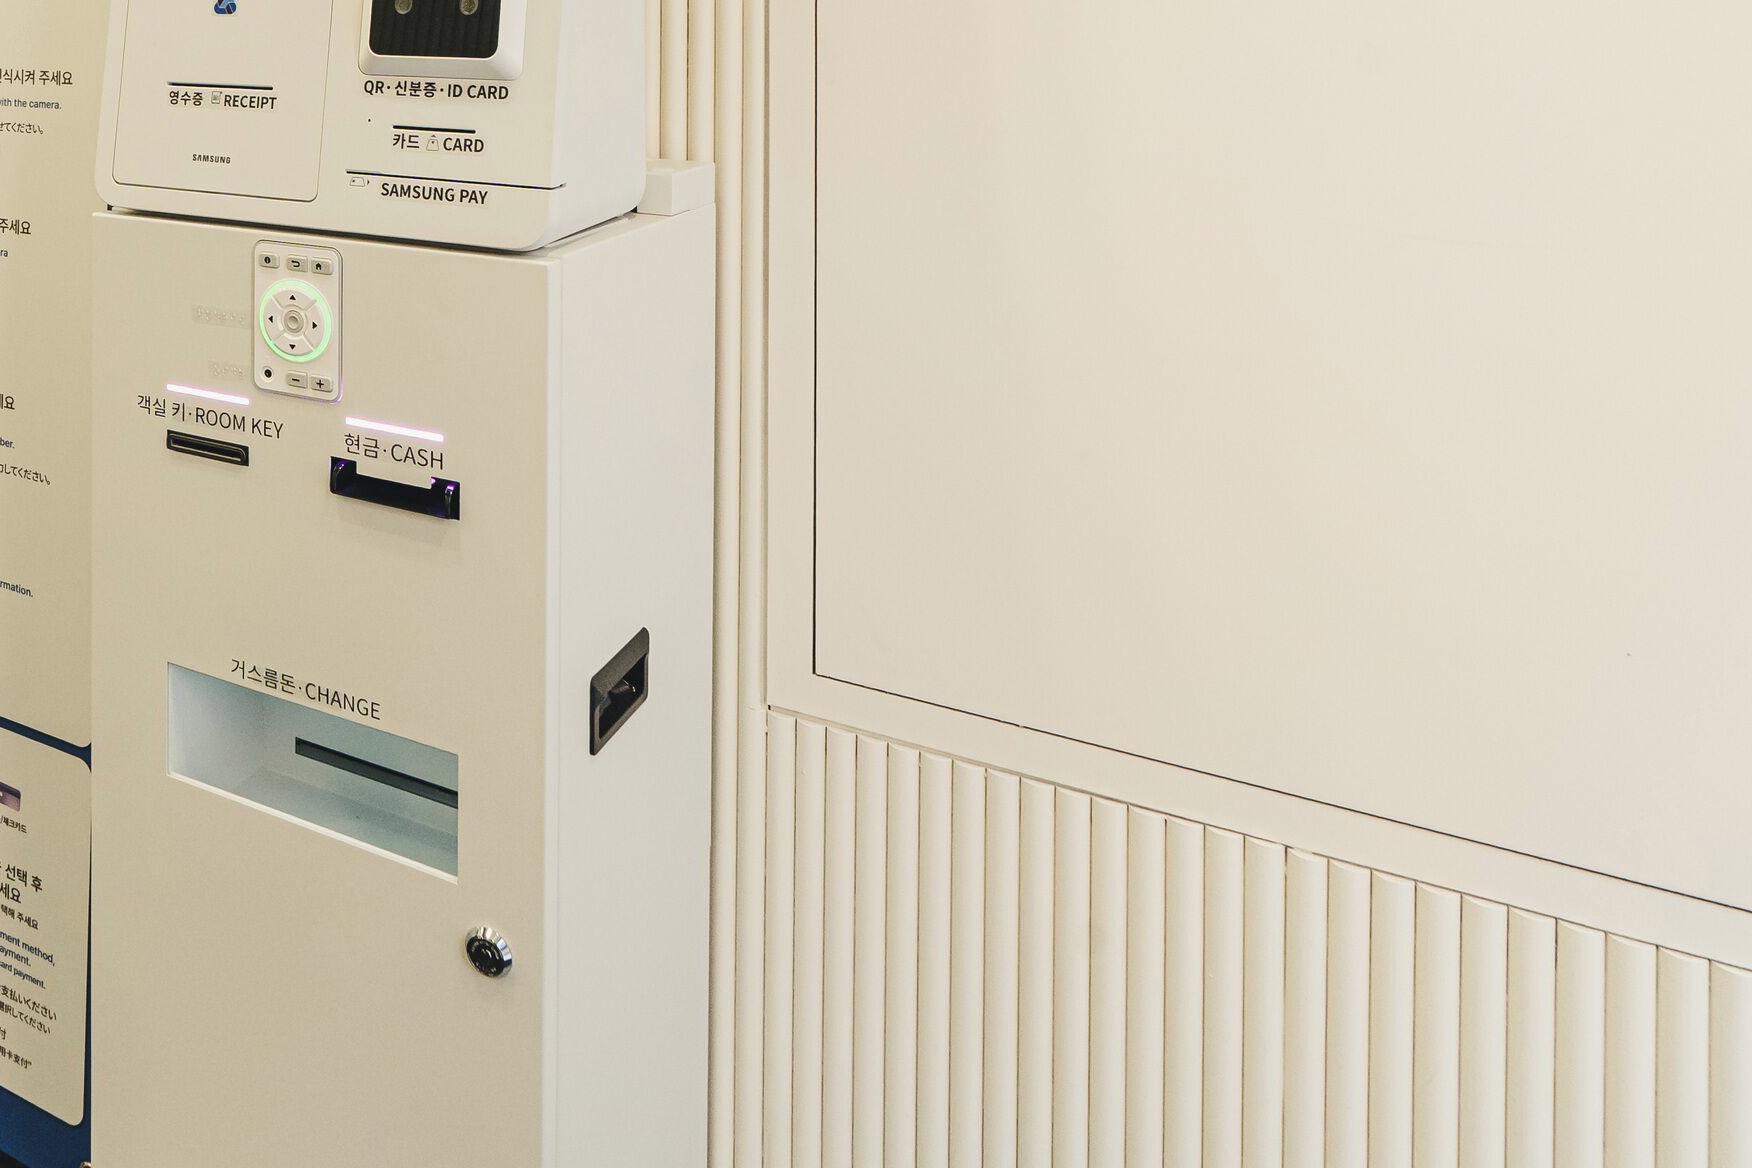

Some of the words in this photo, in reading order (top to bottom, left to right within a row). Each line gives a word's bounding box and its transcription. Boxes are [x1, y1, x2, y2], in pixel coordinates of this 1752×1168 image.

[38, 71, 73, 86] 주세요
[168, 90, 203, 107] 영수증
[467, 83, 509, 101] CARD
[224, 94, 277, 111] RECEIPT
[392, 133, 420, 149] 카드
[443, 136, 485, 153] CARD
[192, 153, 231, 164] SAMSUNG
[380, 182, 455, 202] SAMSUNG
[459, 188, 488, 205] PAY
[137, 395, 166, 417] 객실
[251, 417, 284, 439] KEY
[5, 864, 27, 887] 선택
[31, 874, 43, 893] 후
